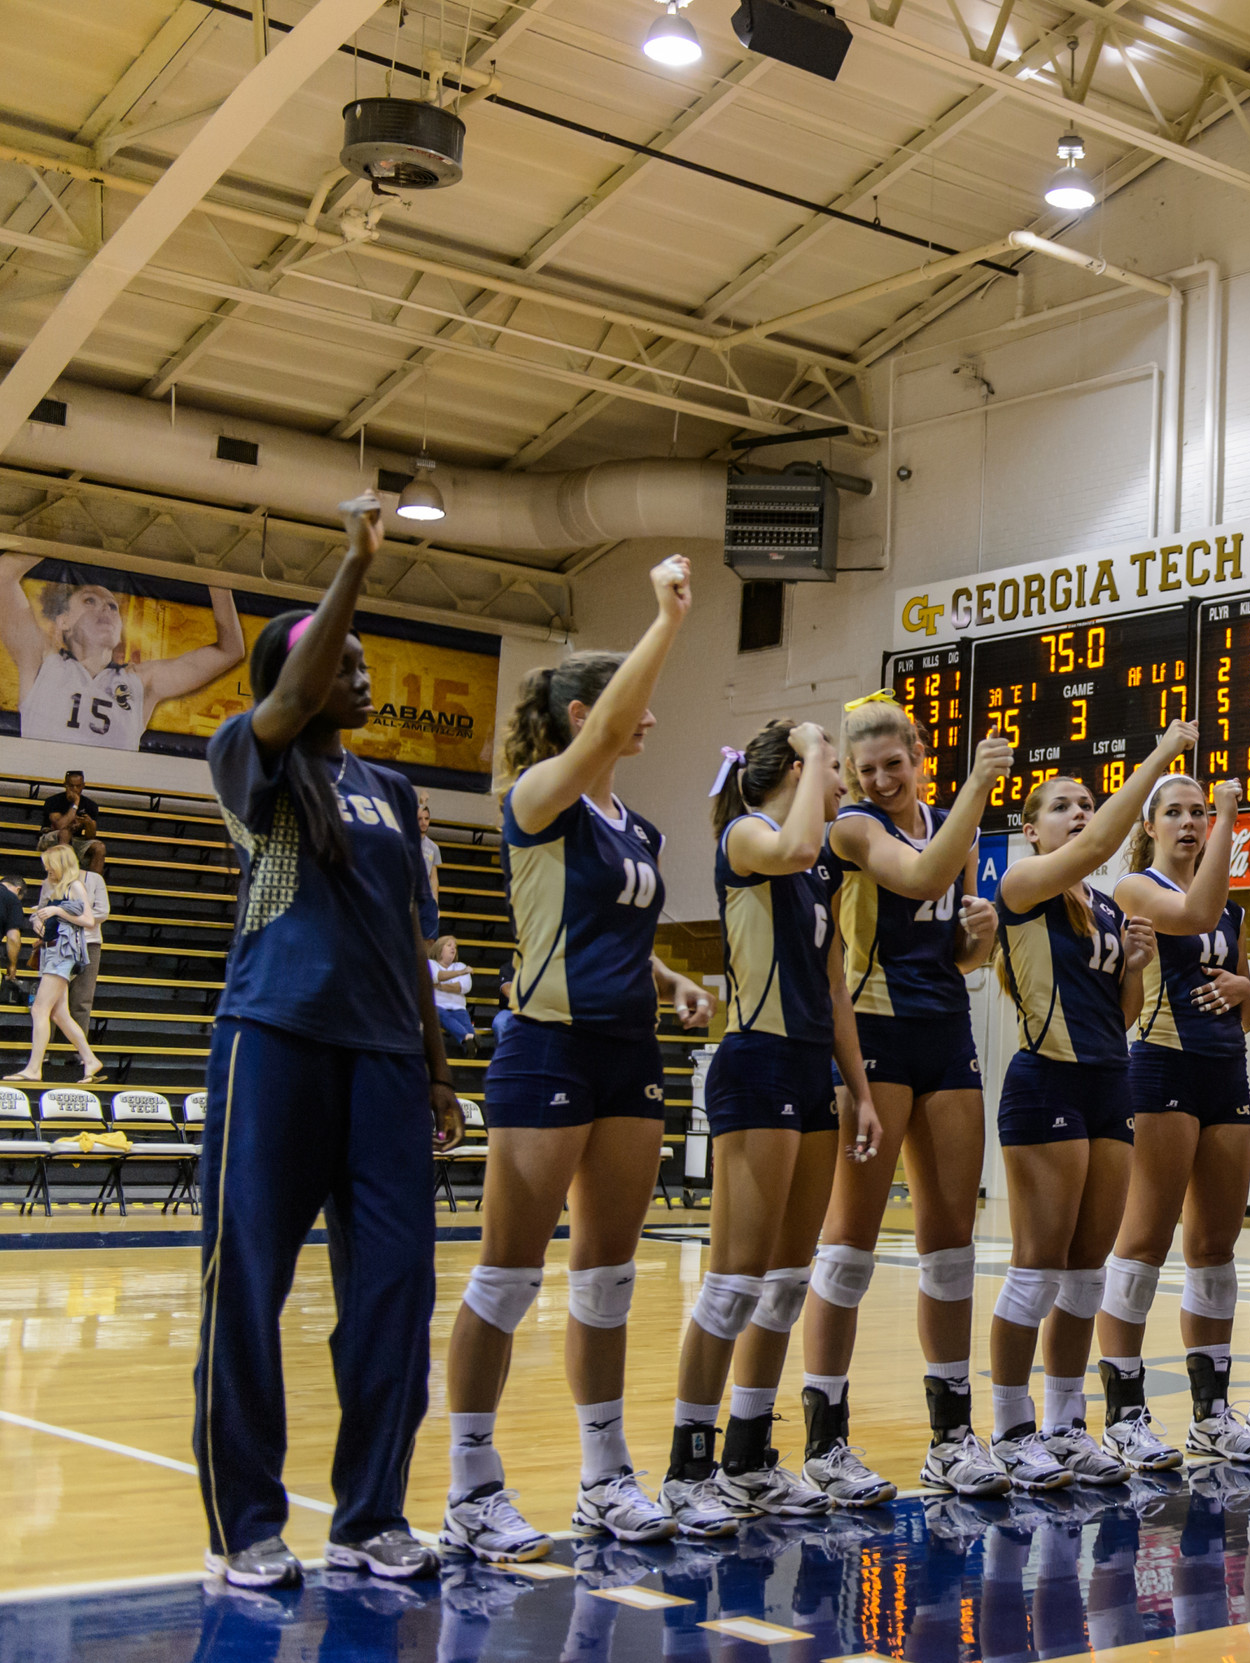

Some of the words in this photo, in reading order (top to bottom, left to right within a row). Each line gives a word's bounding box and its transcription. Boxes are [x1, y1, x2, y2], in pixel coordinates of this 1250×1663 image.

[901, 594, 944, 636] GT
[951, 559, 1119, 629] GEORGIA
[1130, 532, 1243, 597] TECH
[1209, 605, 1229, 621] PLYR
[1041, 627, 1105, 672] 75.0
[898, 659, 914, 673] PLYR
[923, 655, 939, 669] KILLS
[1218, 656, 1231, 682] 2
[905, 677, 915, 700] 5
[1063, 683, 1094, 698] GAME
[1217, 687, 1229, 713] 5
[67, 693, 112, 735] 15
[929, 701, 939, 723] 3
[1071, 700, 1087, 740] 3
[373, 717, 472, 739] ALL-AMERICAN
[1218, 718, 1229, 741] 7
[1029, 749, 1044, 762] LST
[1046, 747, 1060, 760] GM
[1093, 741, 1110, 755] LST
[1111, 739, 1126, 753] GM
[1209, 750, 1228, 774] 14
[1103, 761, 1125, 794] 18
[981, 857, 998, 881] A
[616, 857, 656, 908] 10
[814, 903, 827, 948] 6
[1089, 930, 1119, 975] 12
[1199, 930, 1228, 966] 14
[58, 1102, 88, 1112] TECH
[129, 1104, 159, 1113] TECH
